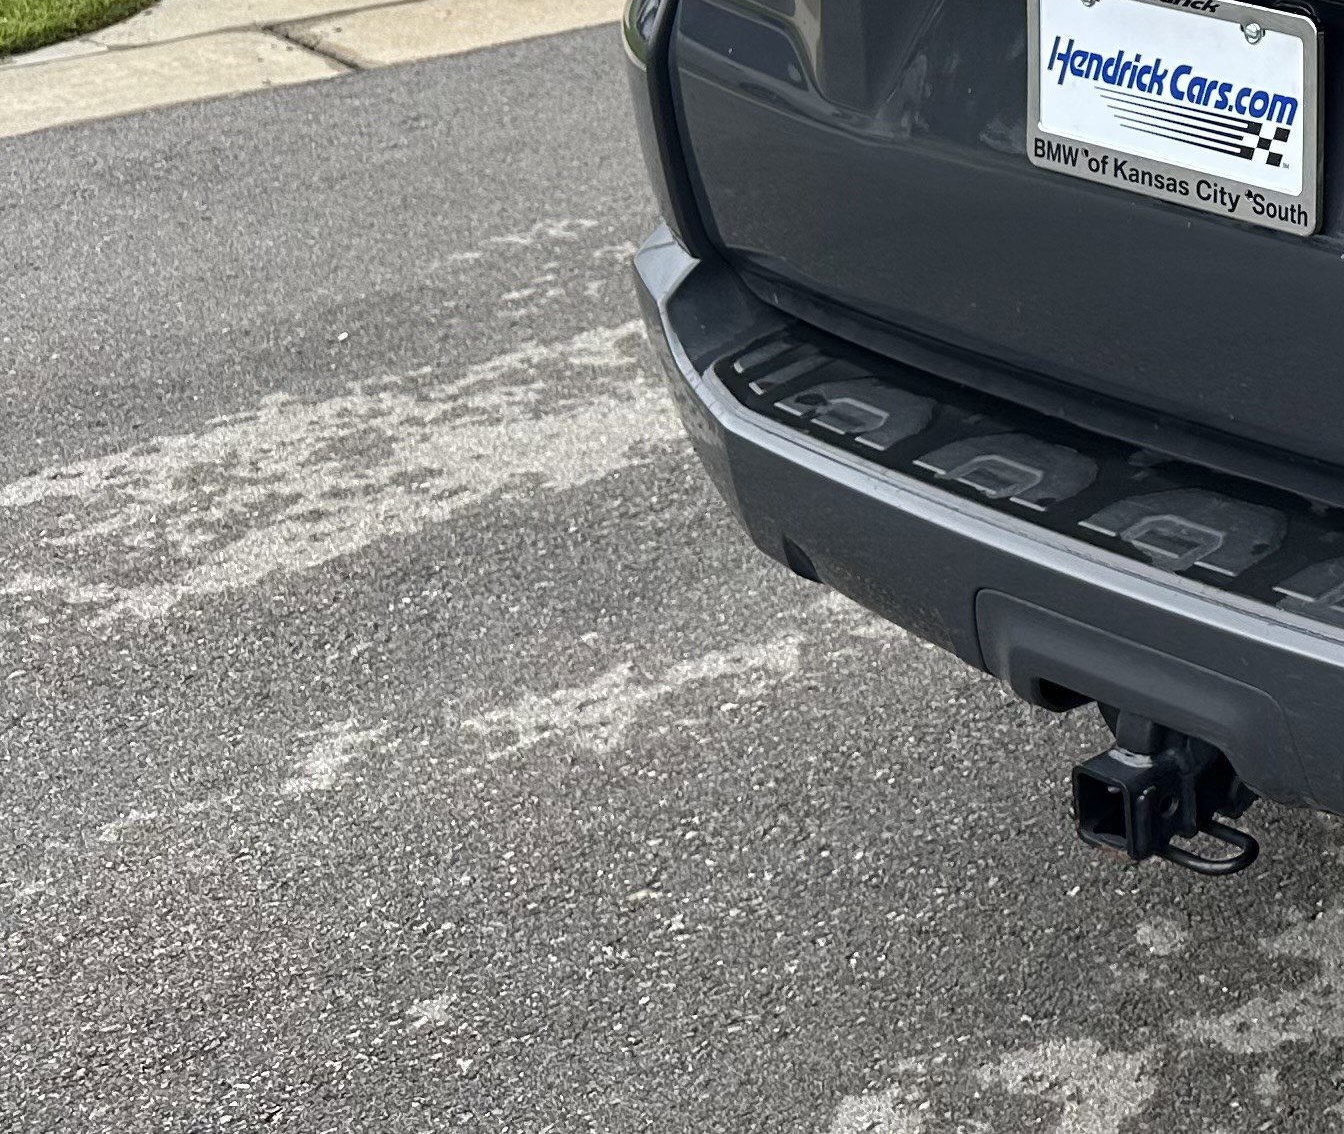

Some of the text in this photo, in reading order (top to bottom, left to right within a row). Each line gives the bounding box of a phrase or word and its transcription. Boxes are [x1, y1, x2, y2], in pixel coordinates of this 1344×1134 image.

[1034, 137, 1308, 227] BMW of Kansas City South
